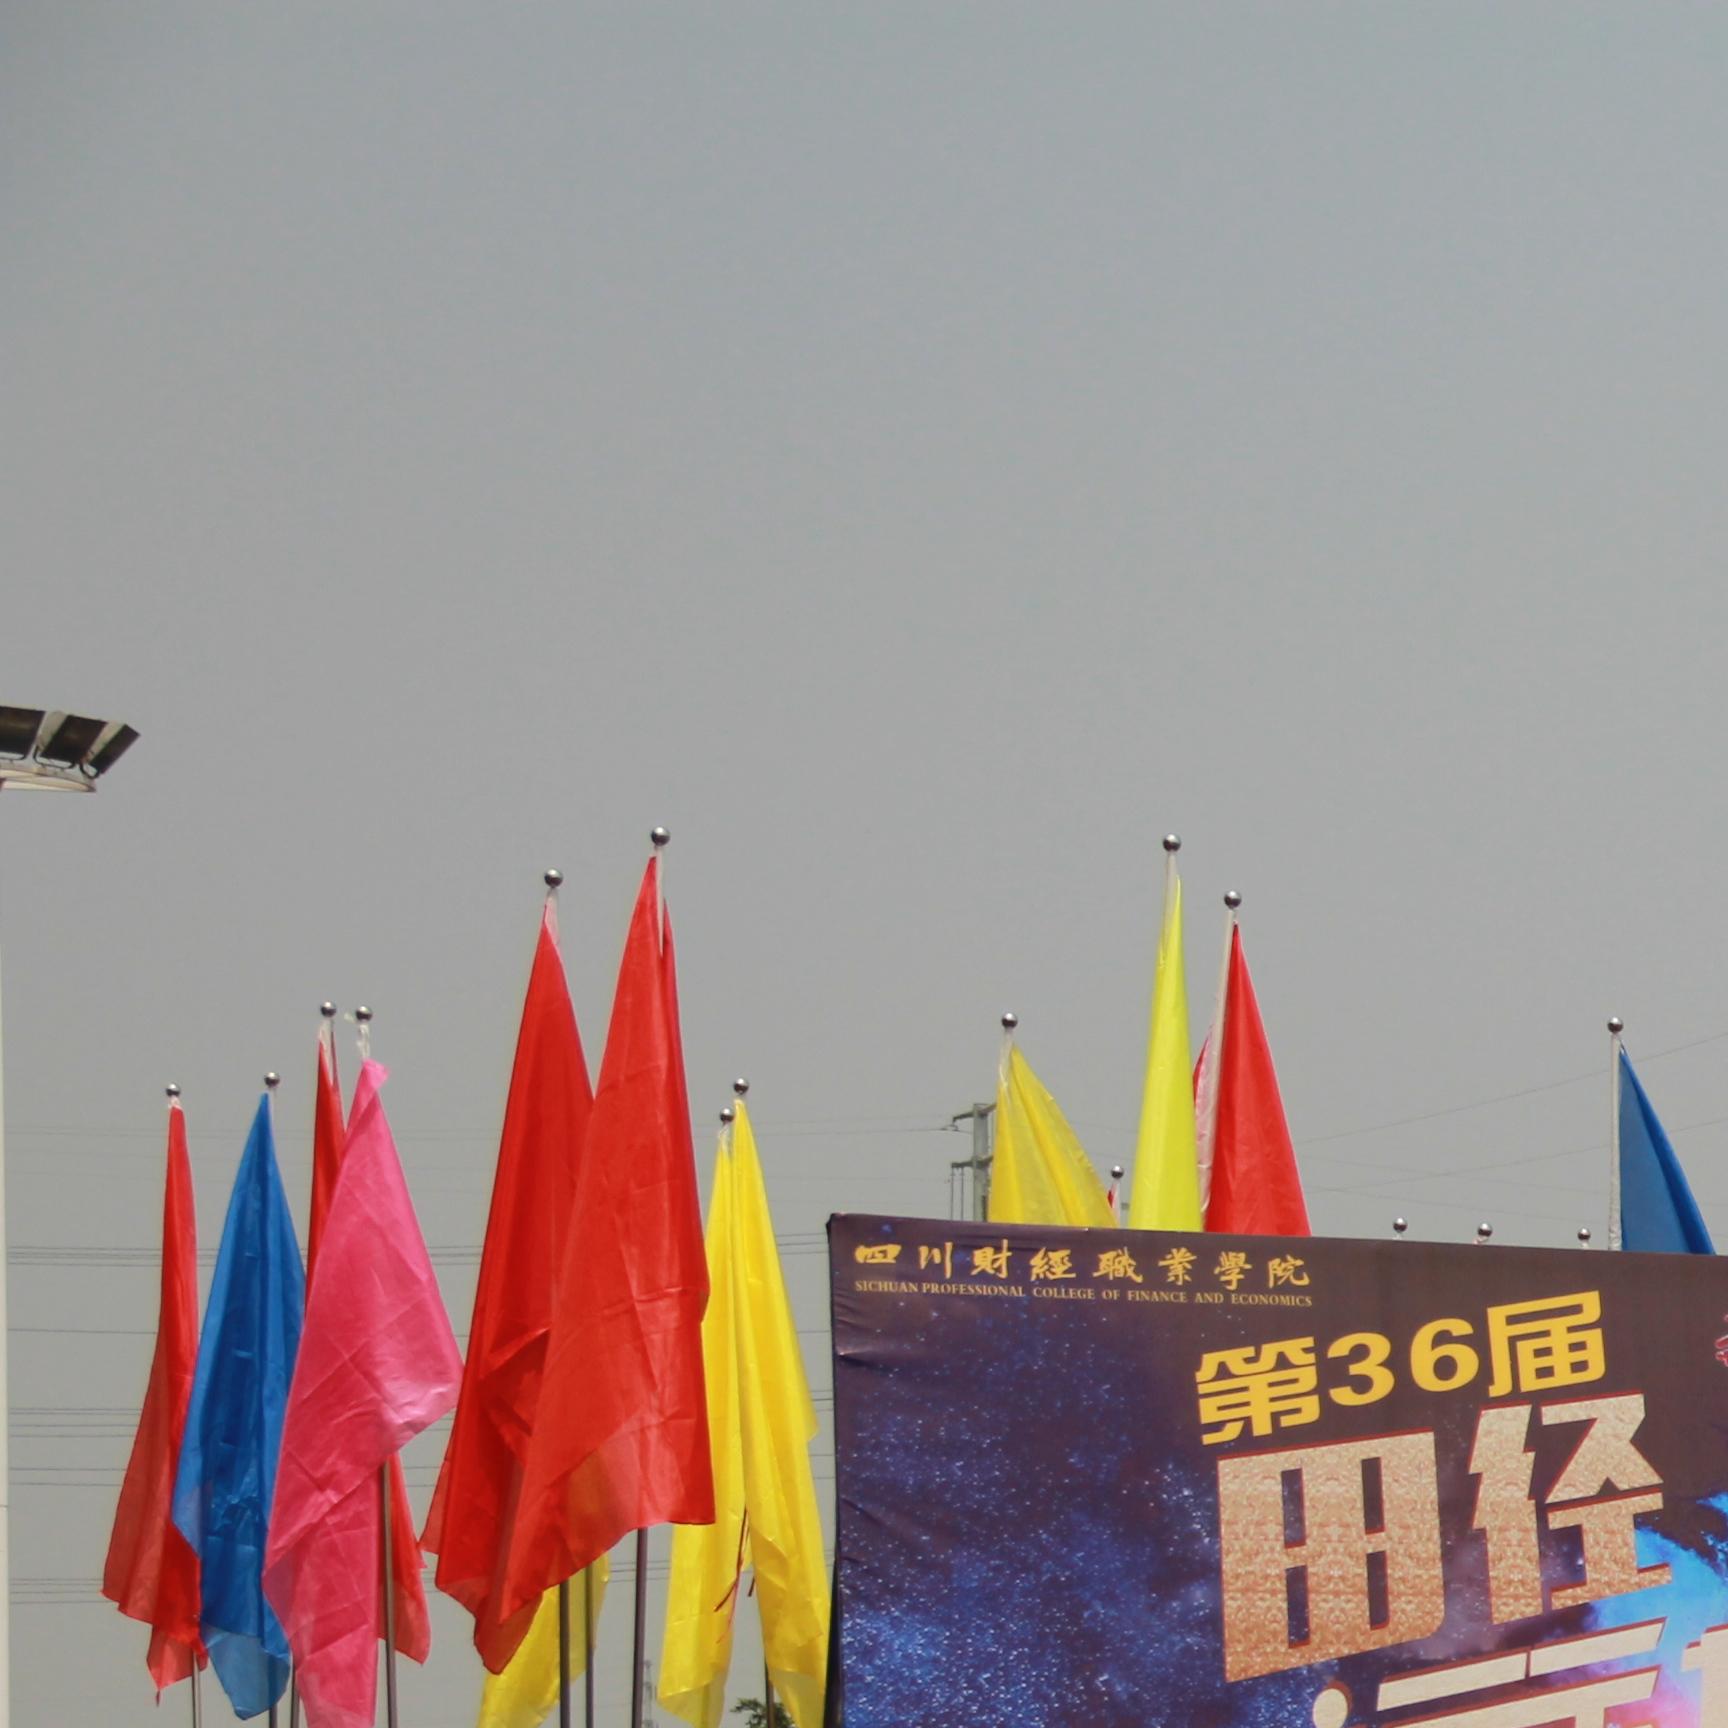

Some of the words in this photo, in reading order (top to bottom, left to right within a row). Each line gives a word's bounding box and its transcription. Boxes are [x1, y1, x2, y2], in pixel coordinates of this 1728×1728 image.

[855, 1280, 919, 1294] SICHUAN
[921, 1282, 1026, 1298] PROFESSIONAL
[1032, 1286, 1095, 1301] COLLEGE
[1101, 1288, 1120, 1300] OF
[1127, 1289, 1187, 1304] FINANCE
[1195, 1291, 1224, 1304] AND
[1231, 1293, 1313, 1308] ECONOMICS
[1196, 1289, 1606, 1446] 第36届
